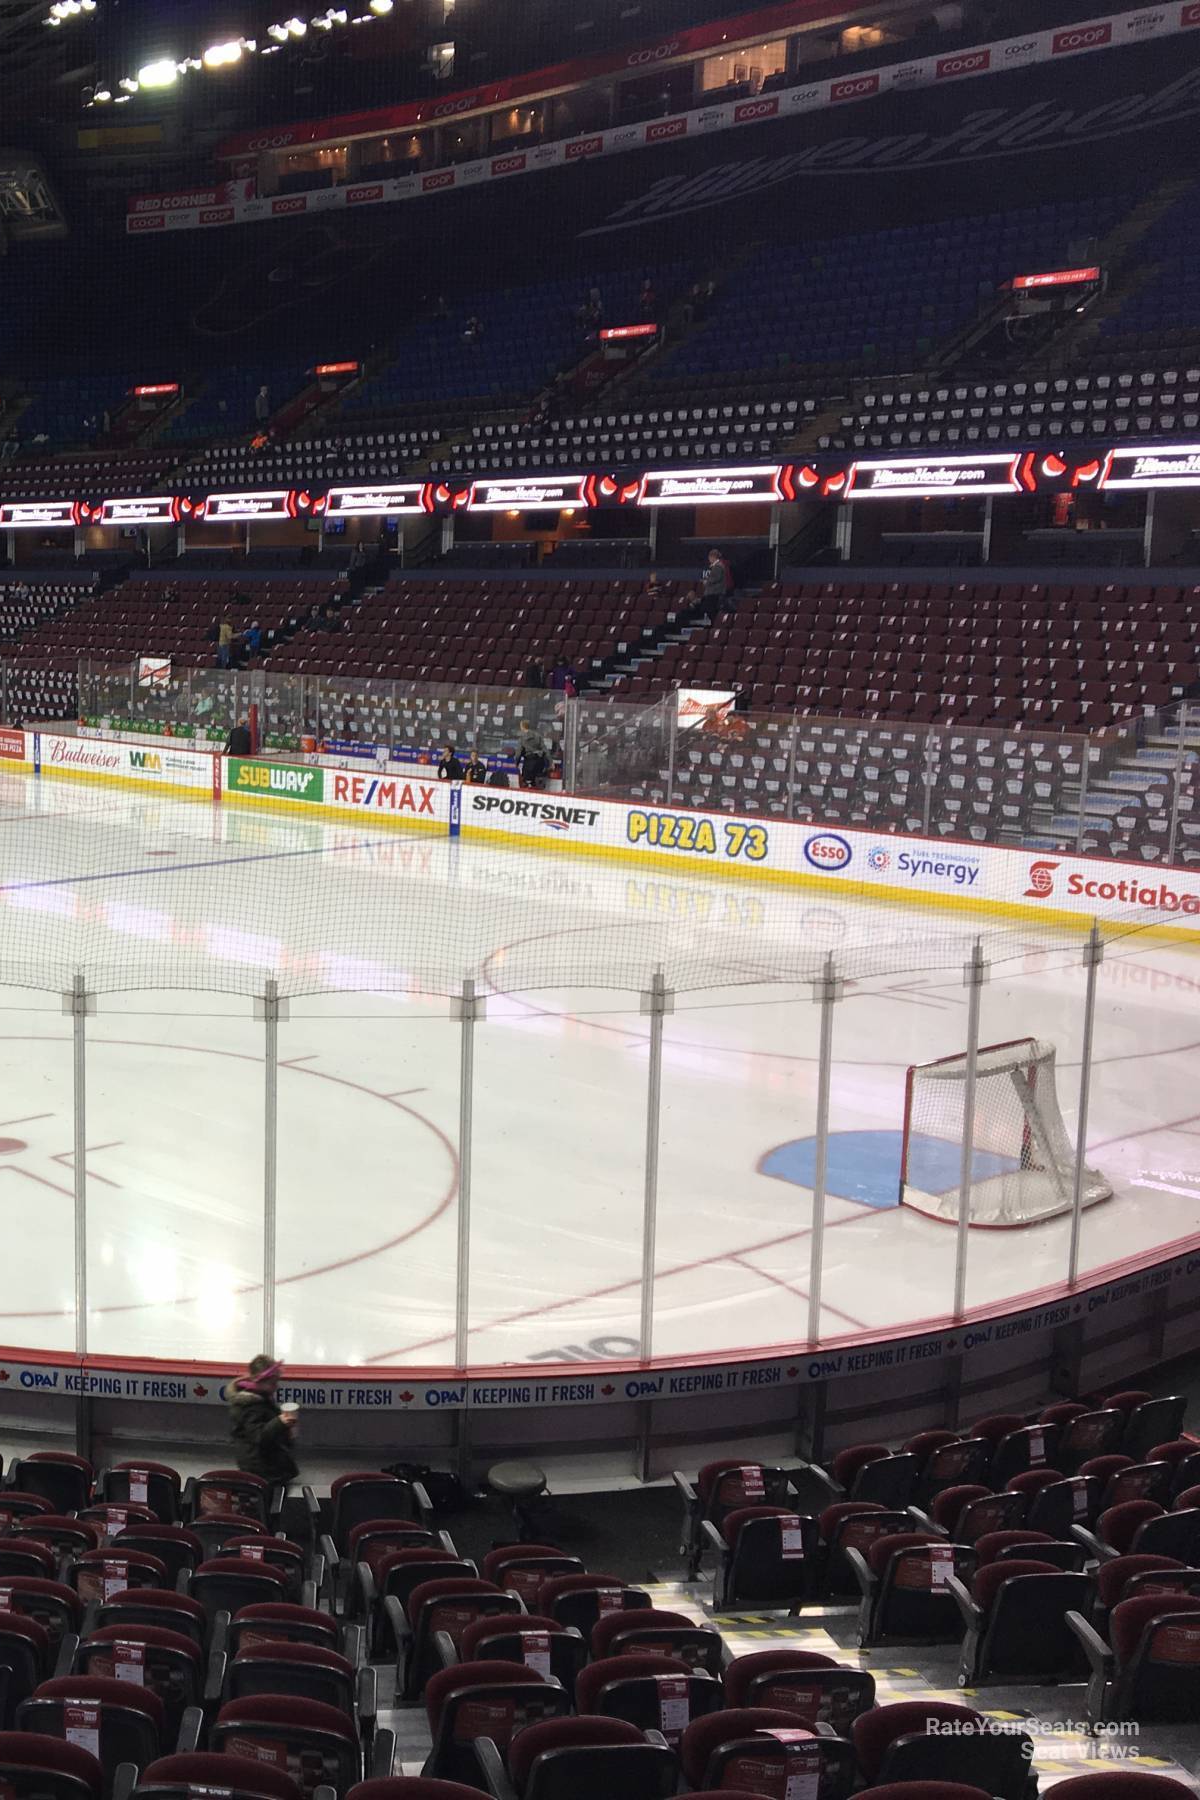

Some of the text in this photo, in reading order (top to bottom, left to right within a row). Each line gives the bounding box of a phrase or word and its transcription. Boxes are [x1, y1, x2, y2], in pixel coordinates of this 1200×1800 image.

[135, 193, 216, 211] RED CORNER
[49, 740, 120, 768] Budweiser
[129, 750, 161, 769] WM
[237, 765, 313, 793] SUBWAY
[334, 775, 435, 815] RE/MAX
[472, 795, 600, 827] SPORTSNET
[627, 810, 769, 861] PIZZA 73
[898, 852, 979, 885] Synergy
[913, 850, 980, 864] FUEL TECHNOLOGY
[1111, 1279, 1141, 1303] KEEPING
[1151, 1267, 1172, 1287] FRESH
[995, 1316, 1033, 1341] KEEPING
[1034, 1314, 1044, 1328] IT
[1044, 1306, 1071, 1326] FRESH
[847, 1347, 893, 1372] KEEPING
[895, 1346, 906, 1363] IT
[909, 1341, 942, 1361] FRESH
[65, 1375, 122, 1394] KEEPING
[126, 1379, 139, 1395] IT
[143, 1381, 187, 1398] FRESH
[473, 1386, 531, 1404] KEEPING
[535, 1386, 548, 1402] IT
[552, 1384, 595, 1402] FRESH
[670, 1371, 723, 1393] KEEPING
[726, 1371, 737, 1388] IT
[742, 1368, 781, 1386] FRESH
[330, 1388, 344, 1405] IT
[348, 1389, 392, 1405] FRESH
